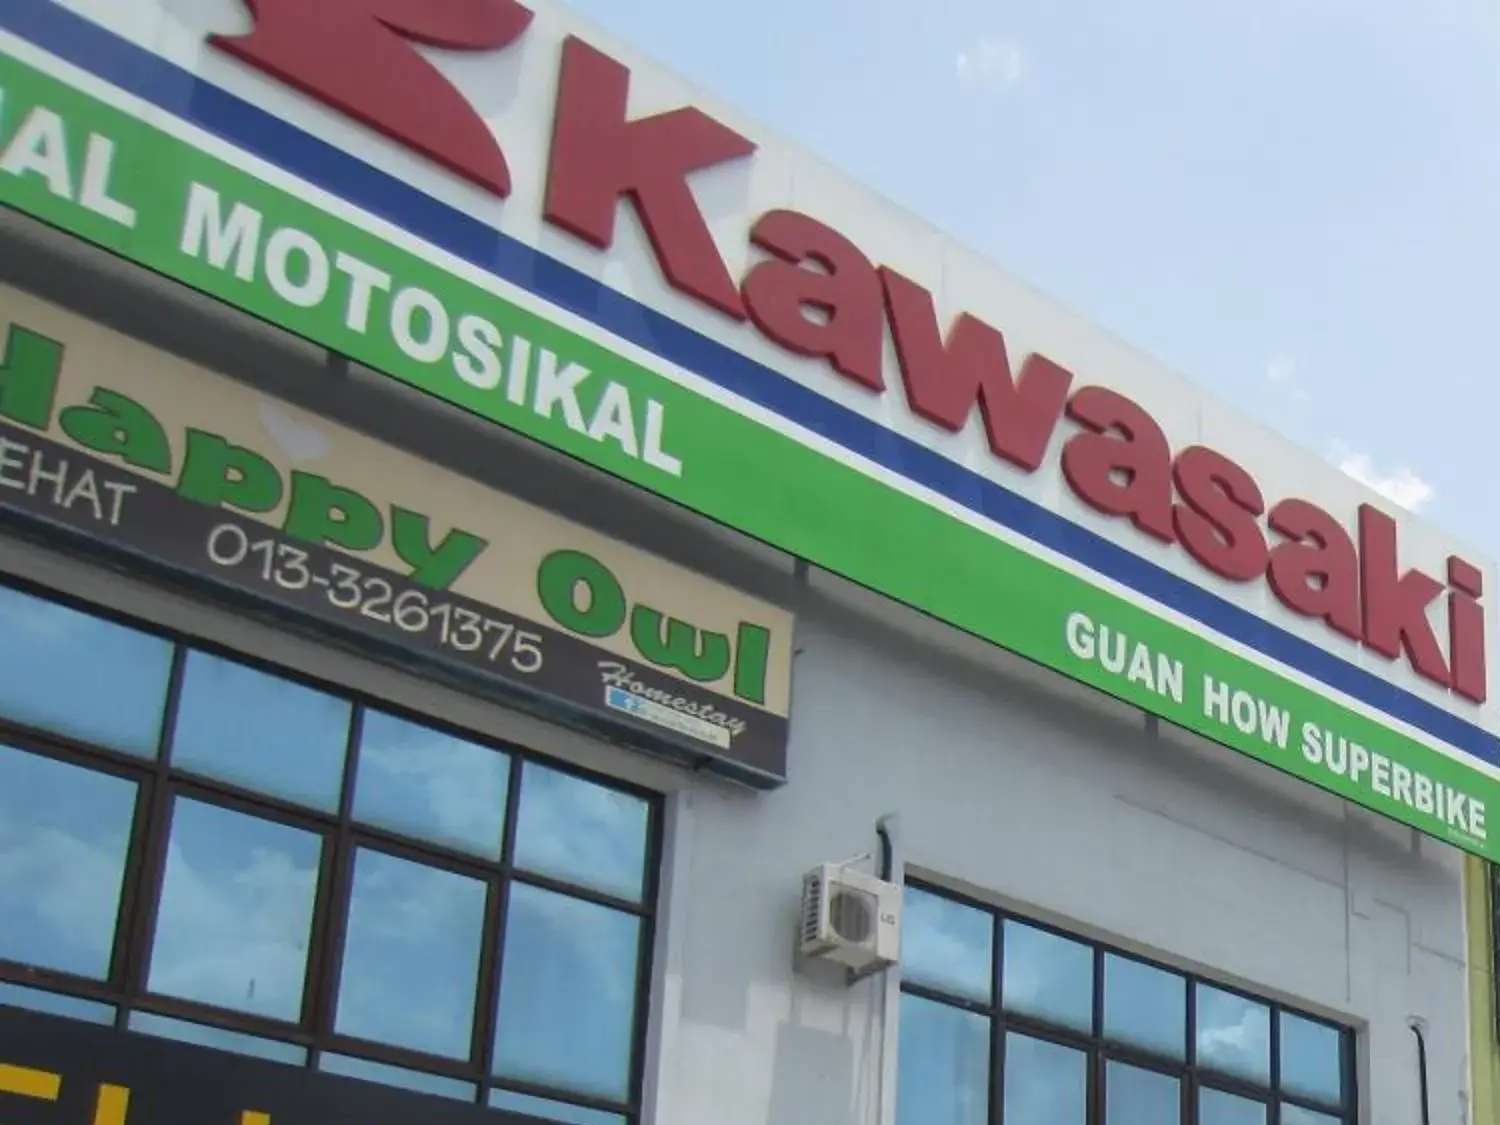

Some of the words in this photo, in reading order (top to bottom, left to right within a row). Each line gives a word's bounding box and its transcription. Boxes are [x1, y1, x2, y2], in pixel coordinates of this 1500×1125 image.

[0, 88, 137, 229] AL
[180, 180, 684, 477] MOTOSIKAL
[545, 34, 1487, 705] Kawasaki
[207, 523, 544, 673] 013-3261375
[537, 548, 773, 706] Owl
[597, 661, 747, 738] Homestay
[1066, 612, 1184, 703] GUAN
[1203, 674, 1290, 749] HOW
[1301, 722, 1487, 840] SUPERBIKE
